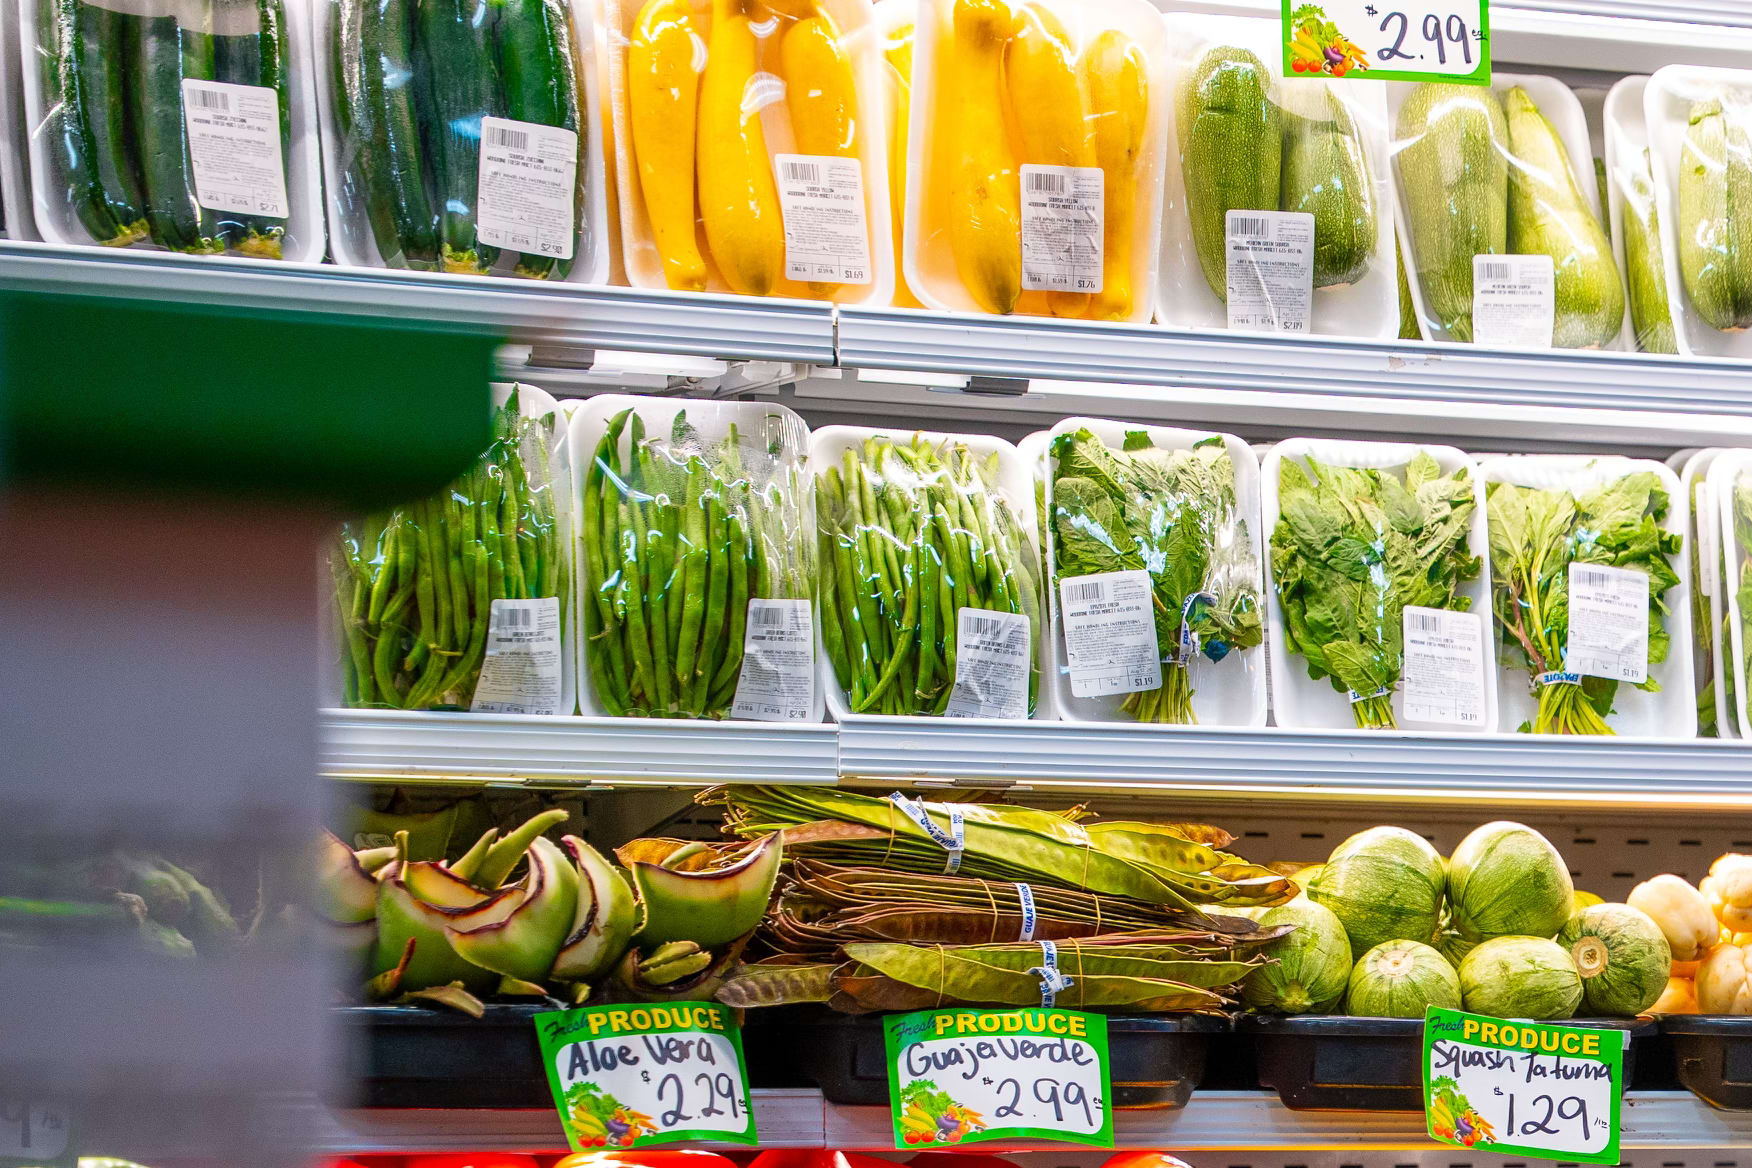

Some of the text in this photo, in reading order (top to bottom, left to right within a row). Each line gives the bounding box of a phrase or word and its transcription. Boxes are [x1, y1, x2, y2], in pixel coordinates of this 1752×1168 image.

[1364, 3, 1472, 65] $2.99
[1024, 907, 1034, 934] GUAJE
[587, 1007, 725, 1035] PRODUCE
[935, 1013, 1088, 1037] PRODUCE
[1463, 1019, 1601, 1056] PRODUCE
[567, 1034, 716, 1080] Aloe Vera
[1431, 1038, 1516, 1078] Squash
